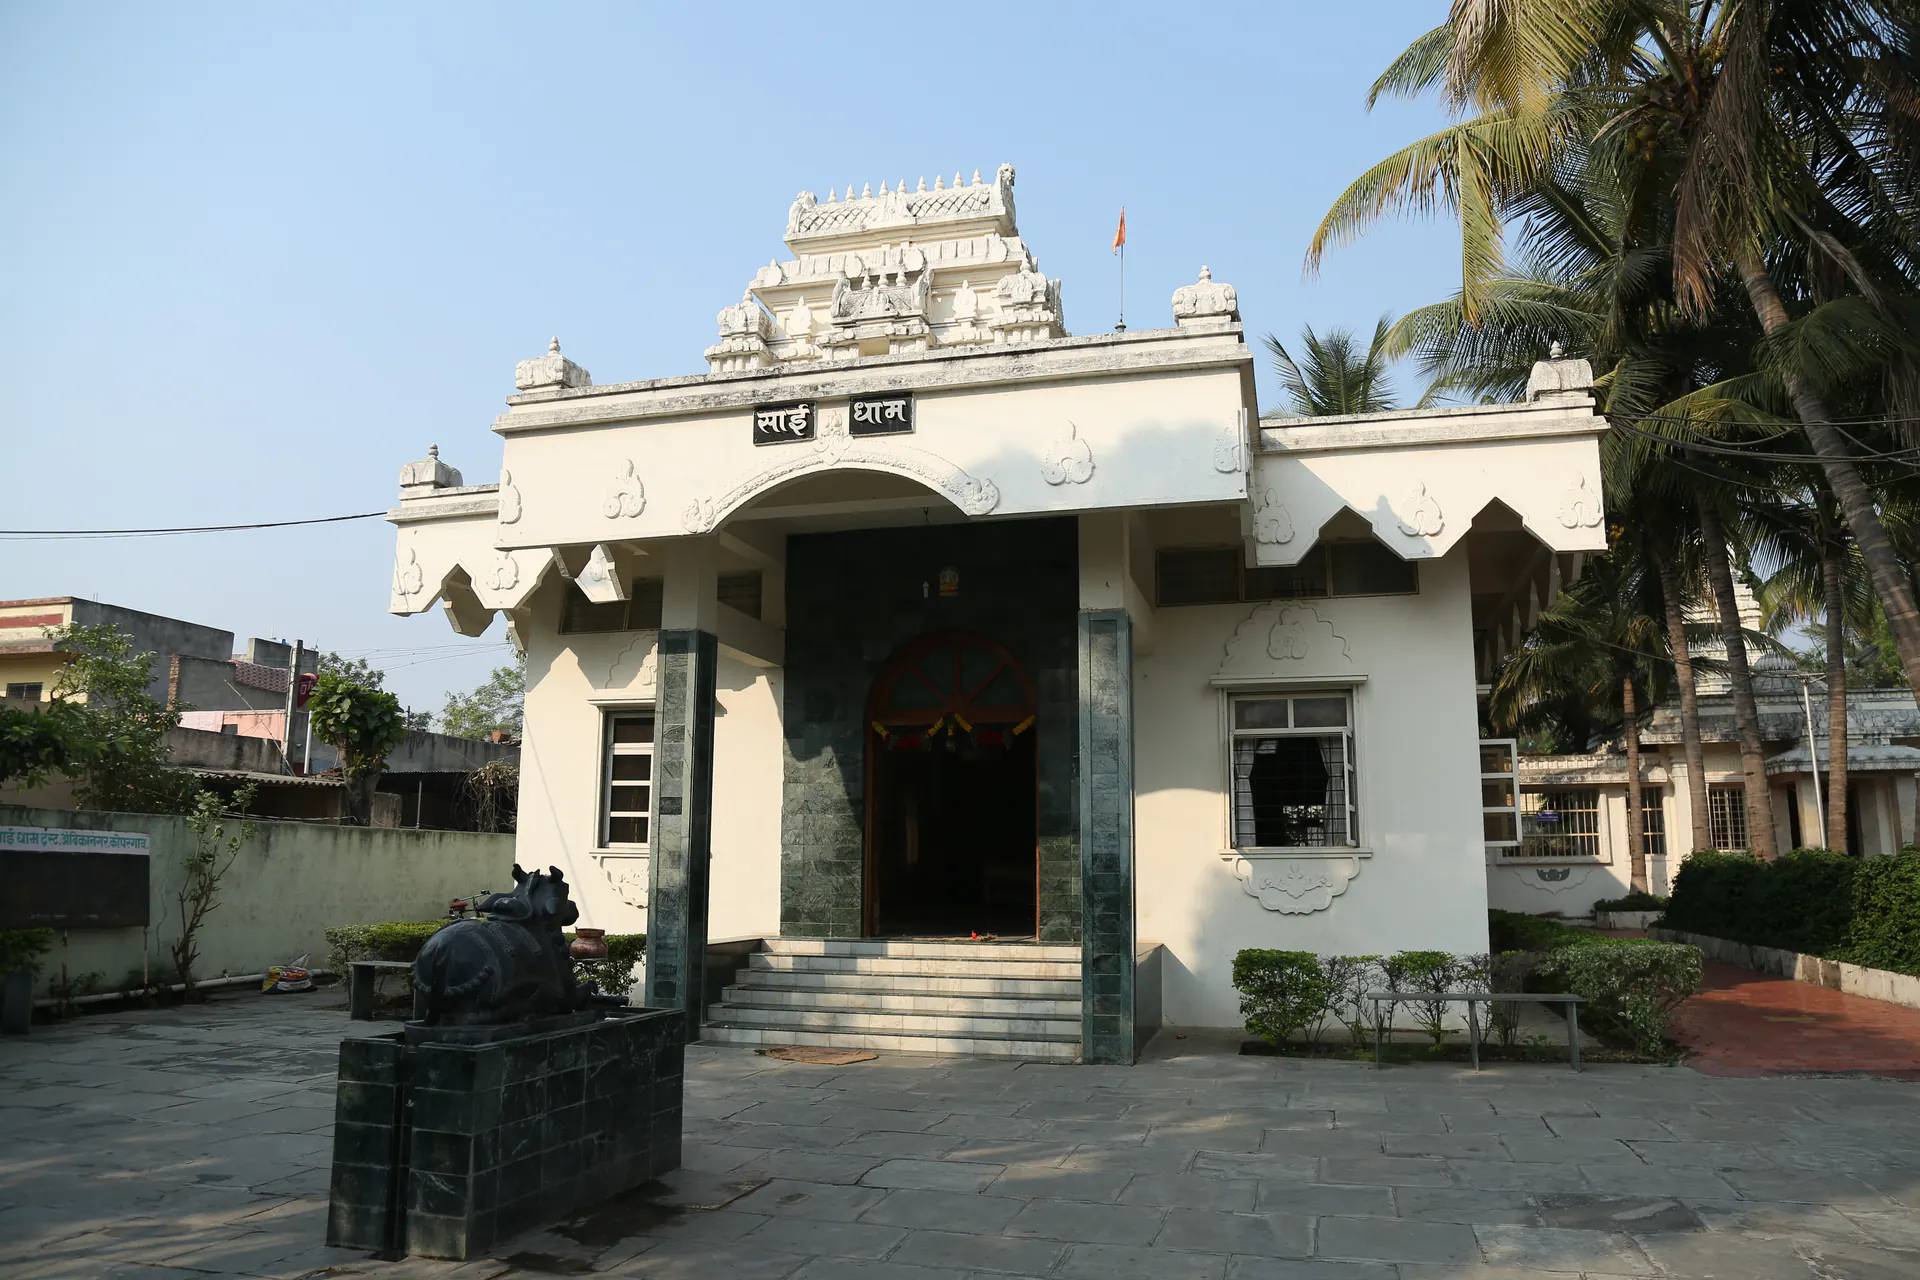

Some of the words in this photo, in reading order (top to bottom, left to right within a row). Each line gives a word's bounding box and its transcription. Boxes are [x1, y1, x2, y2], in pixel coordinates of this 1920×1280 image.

[757, 403, 810, 435] साई
[853, 400, 907, 424] धाम
[0, 828, 15, 844] ाई
[17, 831, 39, 845] धाम
